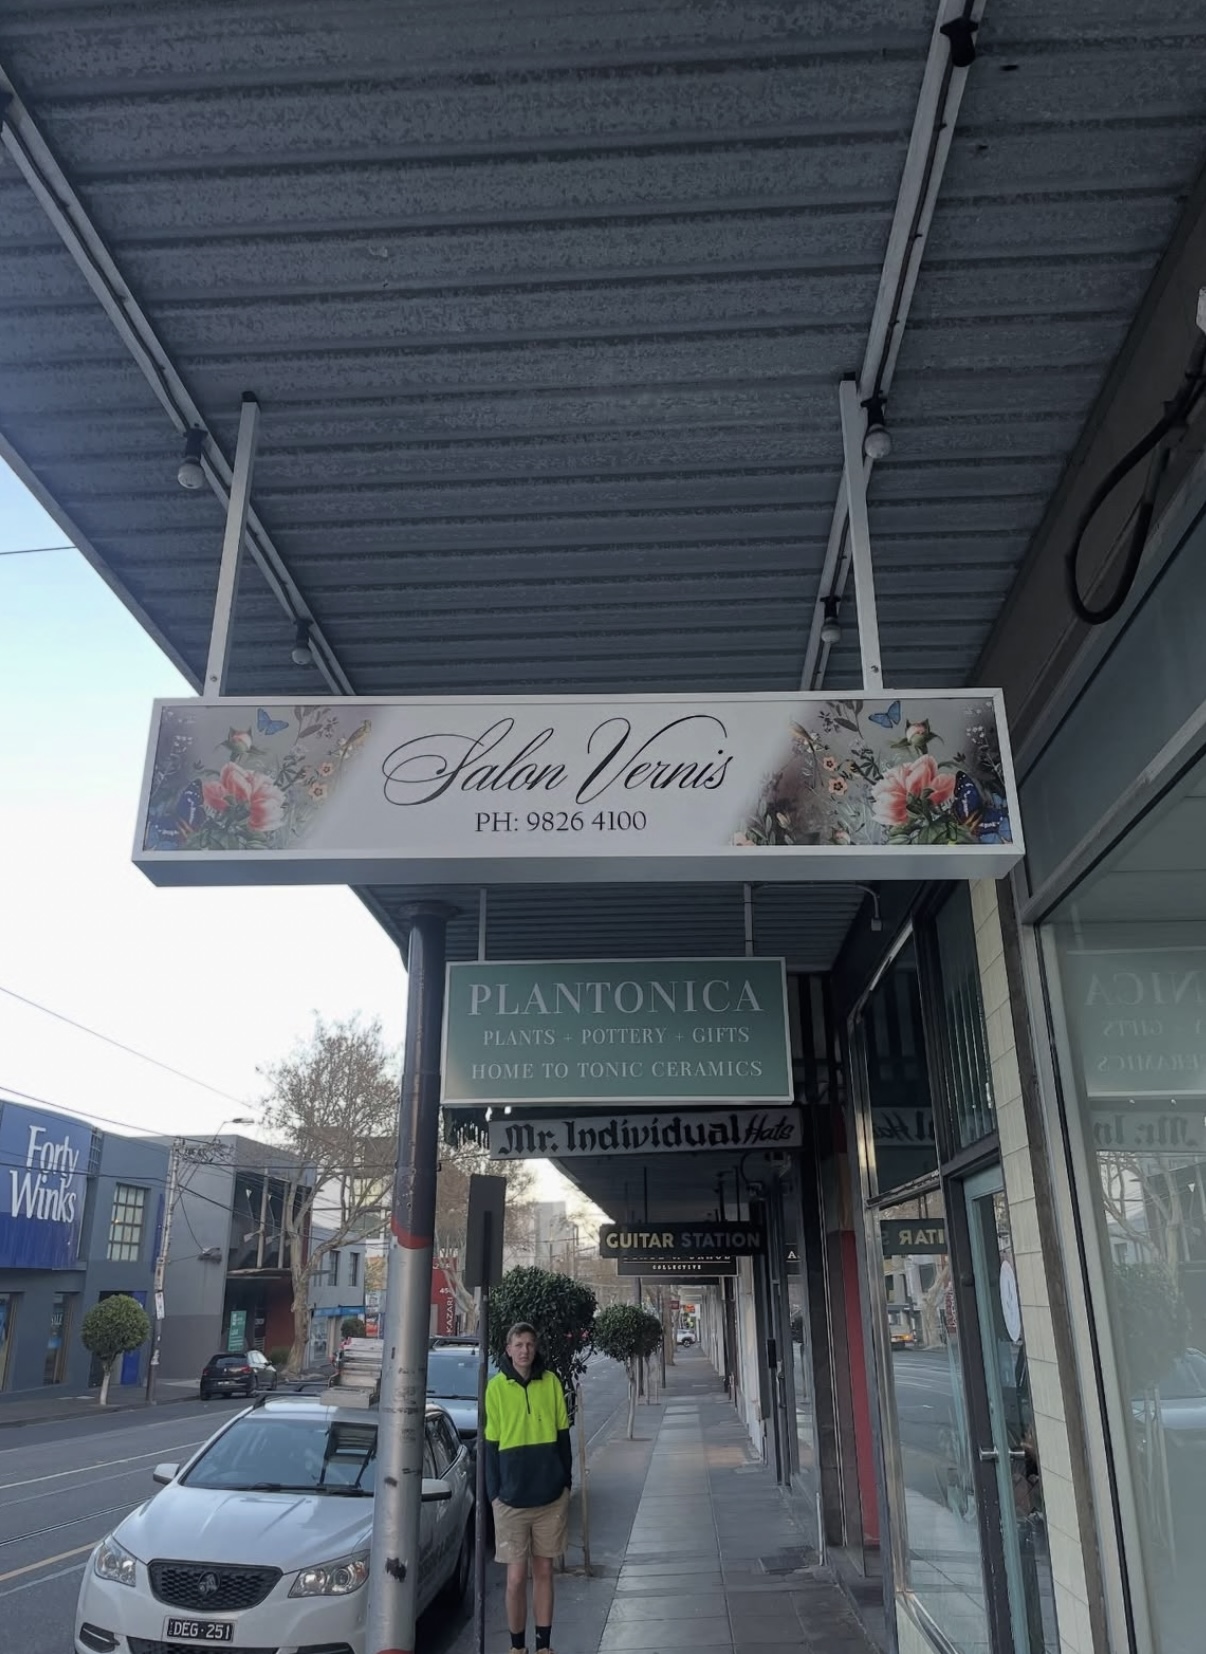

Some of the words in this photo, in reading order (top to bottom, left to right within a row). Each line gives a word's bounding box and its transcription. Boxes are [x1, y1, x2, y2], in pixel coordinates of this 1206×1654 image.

[382, 717, 568, 806] Salon
[575, 714, 734, 805] Vernis
[475, 811, 519, 832] PH:
[526, 810, 584, 832] 9826
[592, 810, 647, 831] 4100
[467, 980, 764, 1016] PLANTONICA
[483, 1029, 556, 1046] PLANTS
[581, 1027, 668, 1045] POTTERY
[692, 1026, 750, 1043] GIFTS
[471, 1063, 533, 1080] HOME
[541, 1063, 569, 1079] TO
[577, 1062, 643, 1078] TONIC
[651, 1060, 763, 1077] CERAMICS
[500, 1123, 558, 1155] Mr.
[562, 1113, 742, 1152] Individual
[740, 1112, 795, 1145] Hats
[26, 1125, 79, 1189] Forty
[9, 1169, 77, 1224] Winks
[606, 1232, 675, 1249] GUITAR
[681, 1231, 761, 1248] STATION
